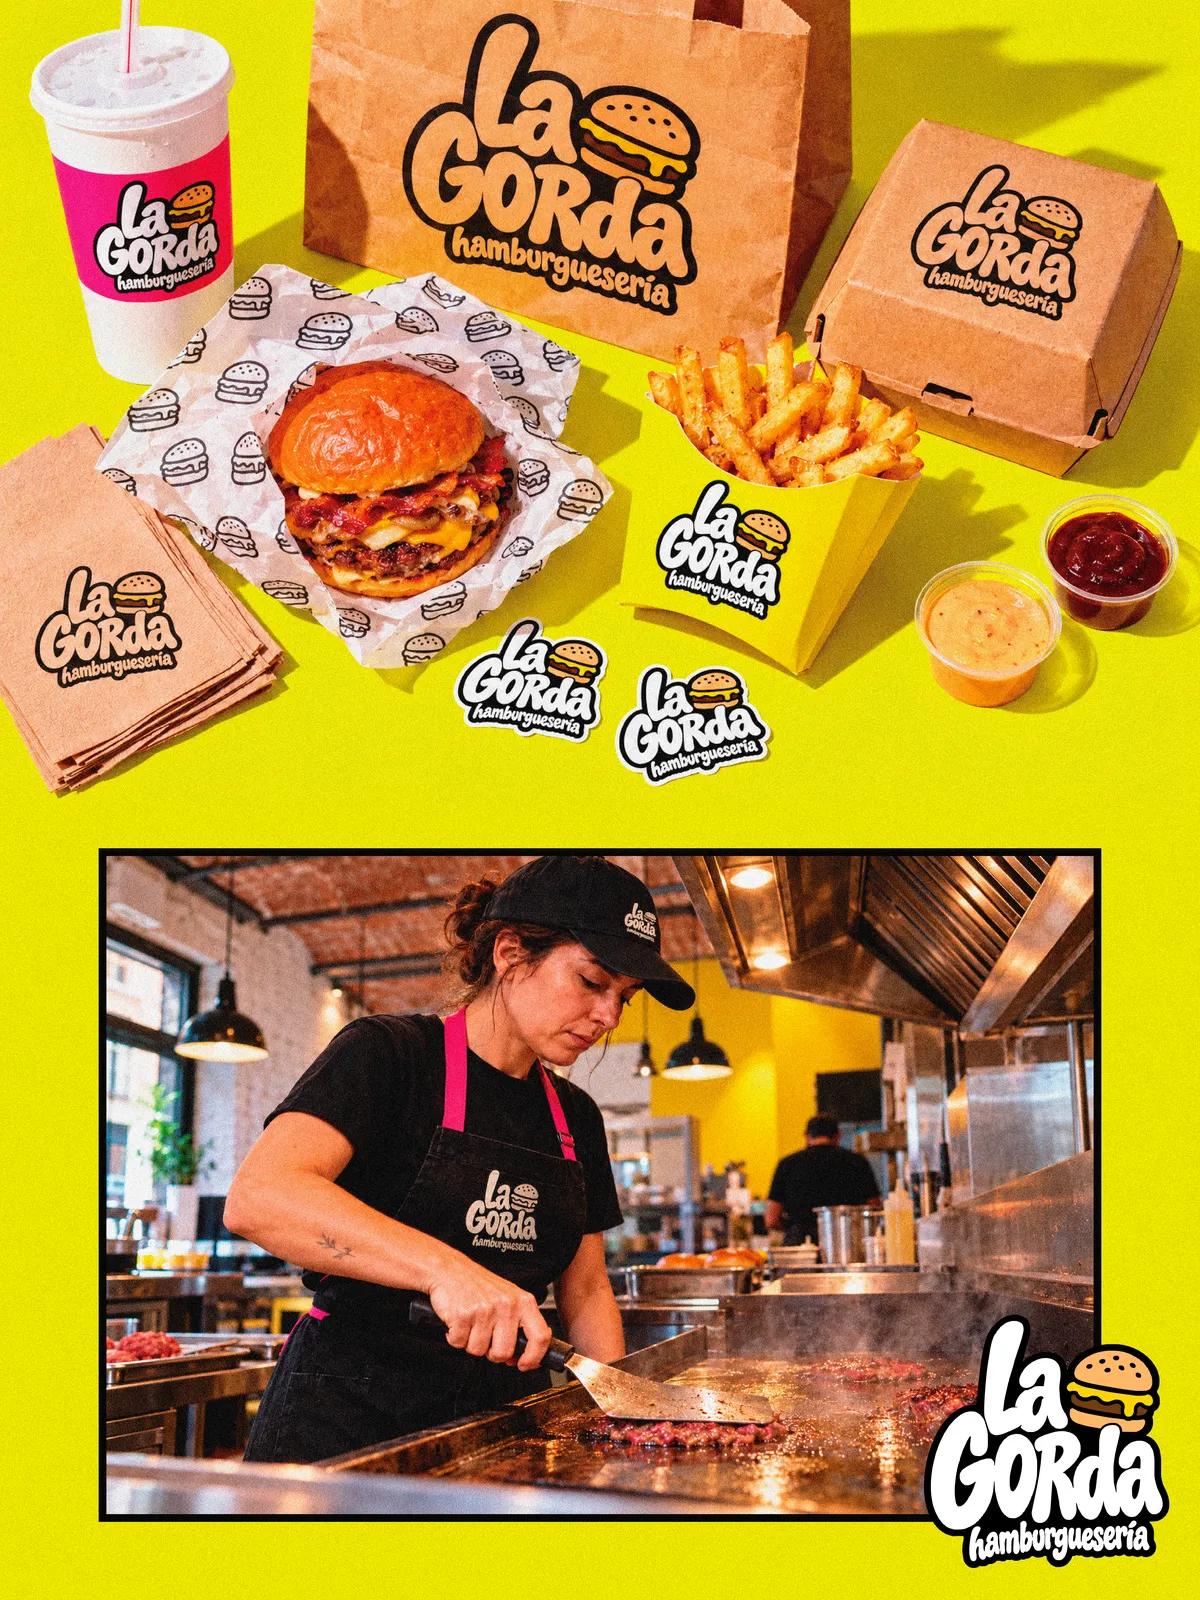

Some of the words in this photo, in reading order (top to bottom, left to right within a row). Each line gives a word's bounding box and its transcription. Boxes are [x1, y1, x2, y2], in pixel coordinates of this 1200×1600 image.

[474, 23, 577, 164] La
[121, 184, 170, 239] La
[964, 168, 1020, 233] La
[117, 257, 214, 290] hamburguesería
[452, 226, 670, 309] hamburguesería
[928, 266, 1058, 317] hamburguesería
[694, 483, 738, 543] La
[68, 569, 116, 625] La
[668, 569, 765, 616] hamburguesería
[61, 651, 173, 685] hamburguesería
[502, 623, 549, 673] La
[472, 703, 581, 735] hamburguesería
[645, 671, 694, 722] La
[650, 739, 759, 778] hamburguesería
[632, 902, 644, 921] La
[484, 1169, 511, 1211] La
